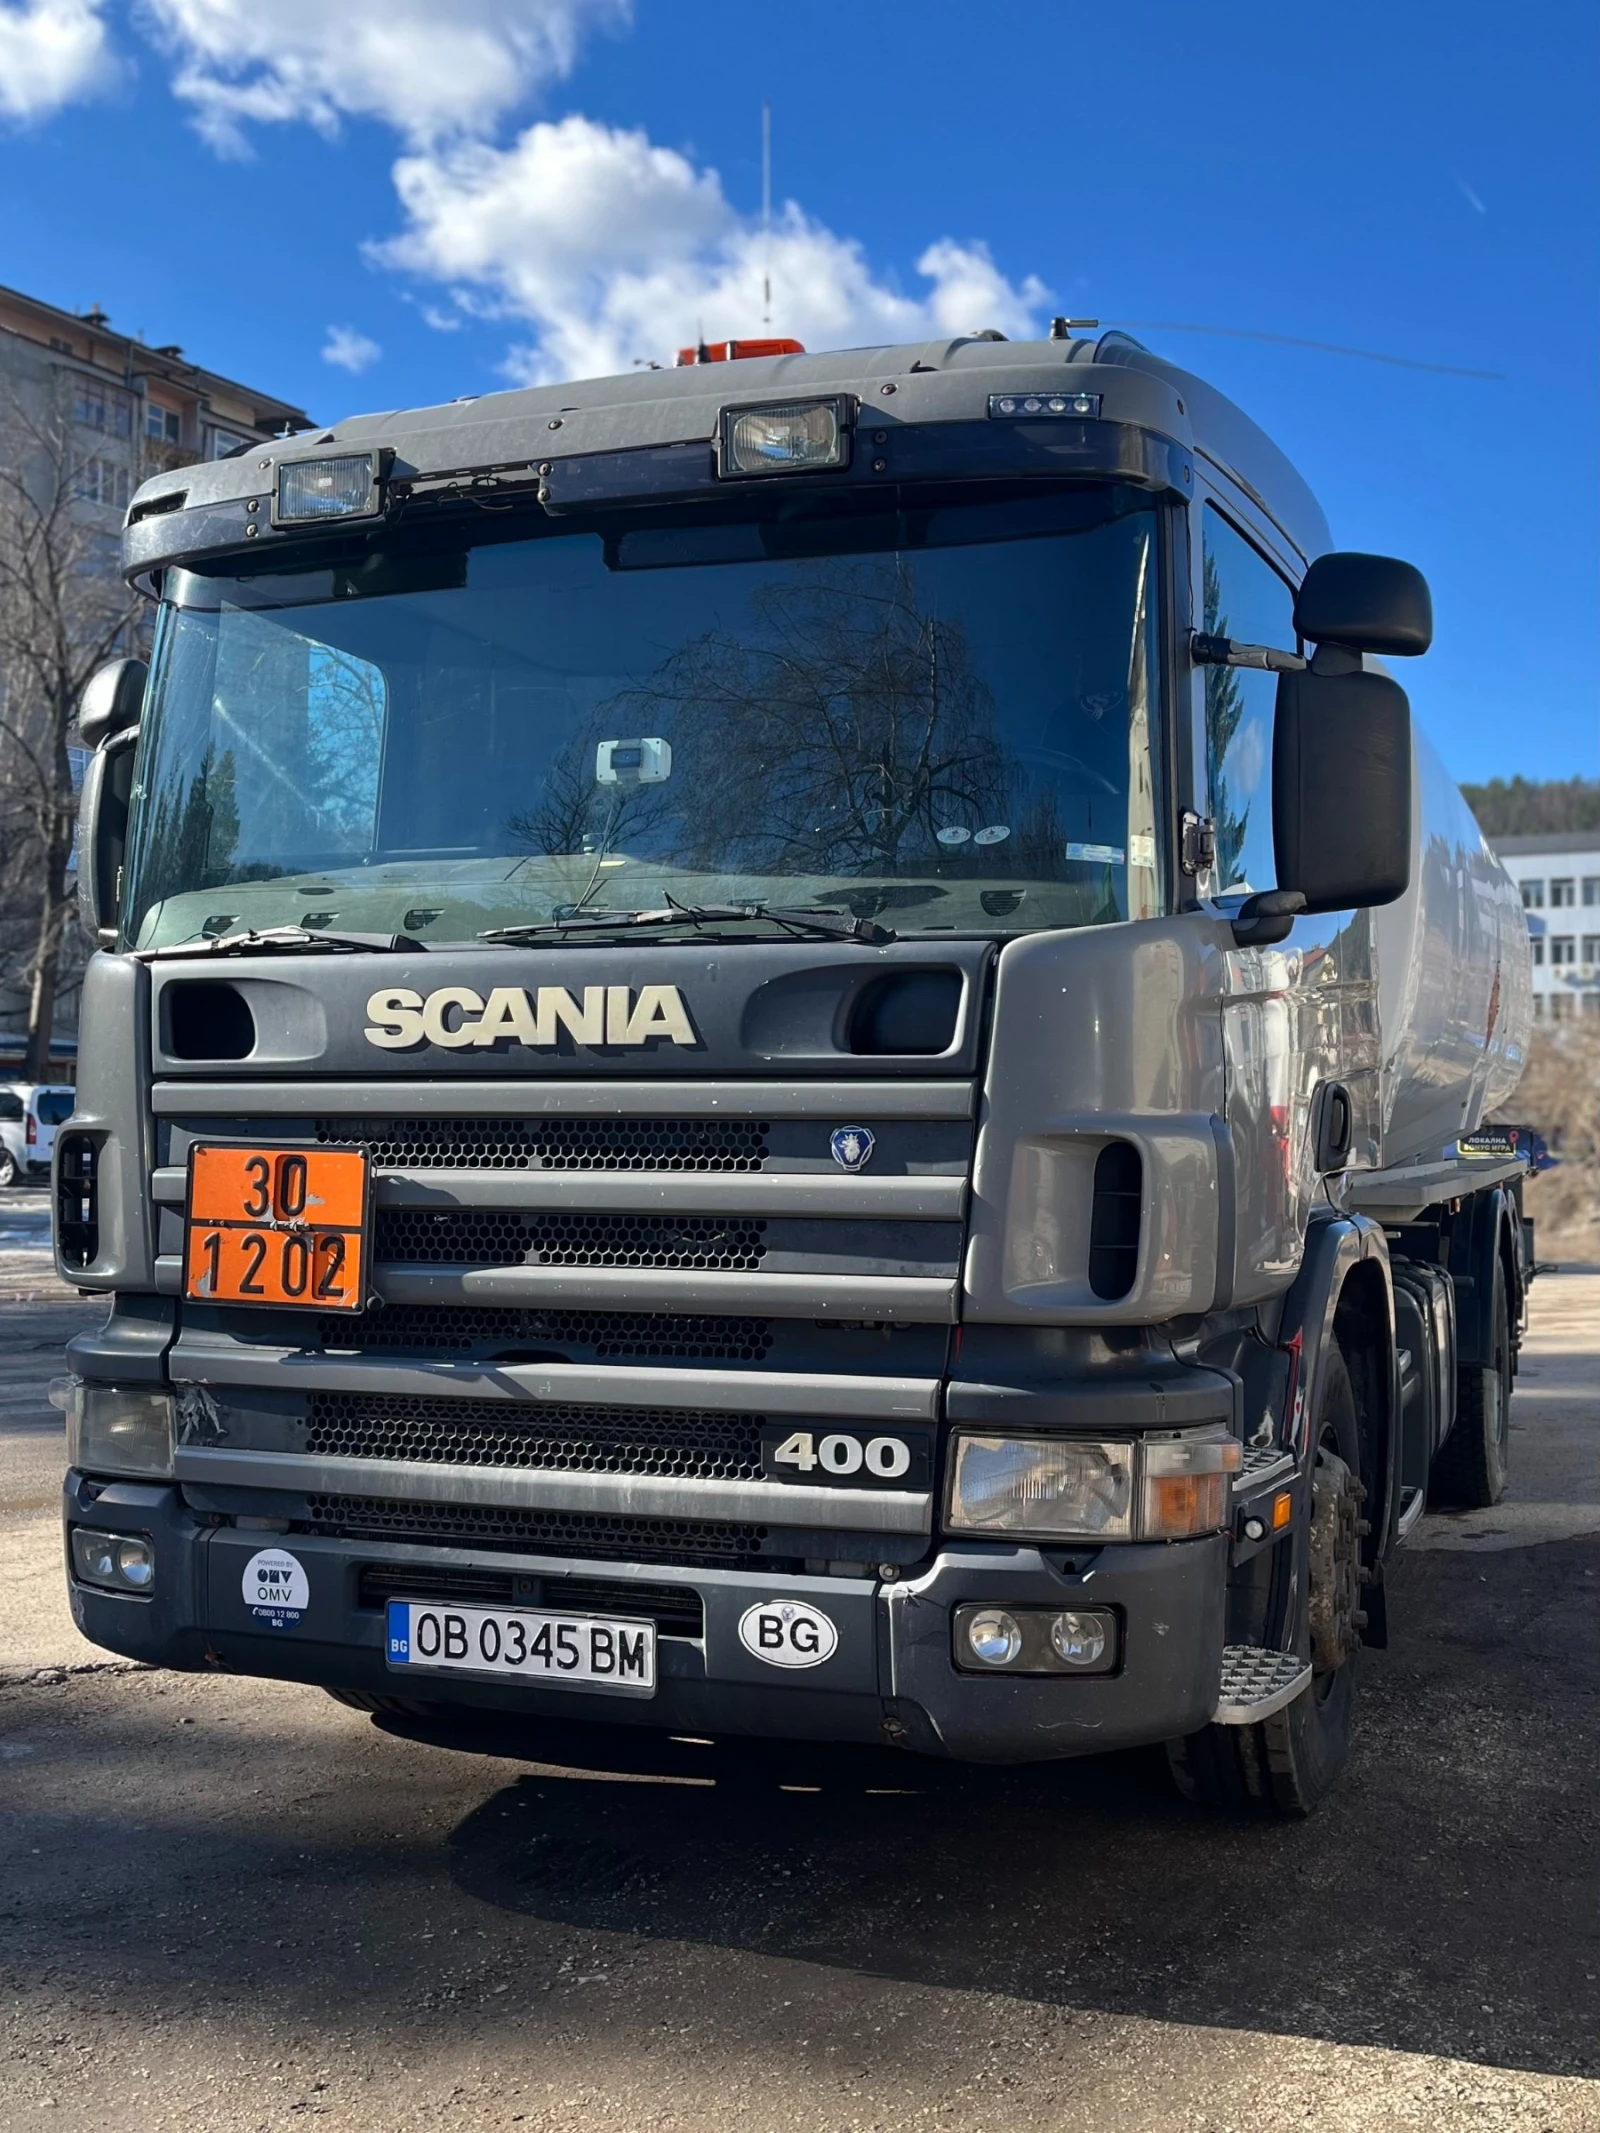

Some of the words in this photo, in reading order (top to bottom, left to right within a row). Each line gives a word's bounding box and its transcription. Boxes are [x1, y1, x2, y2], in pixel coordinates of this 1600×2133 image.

[364, 985, 697, 1048] SCANIA
[244, 1155, 307, 1217] 30
[203, 1232, 346, 1297] 1202
[774, 1432, 911, 1478] 400
[257, 1587, 292, 1602] OMV
[258, 1608, 275, 1617] 0800
[276, 1610, 285, 1618] 12
[286, 1611, 300, 1619] 800
[271, 1619, 283, 1627] BG
[758, 1614, 821, 1654] BG
[391, 1639, 408, 1653] BG
